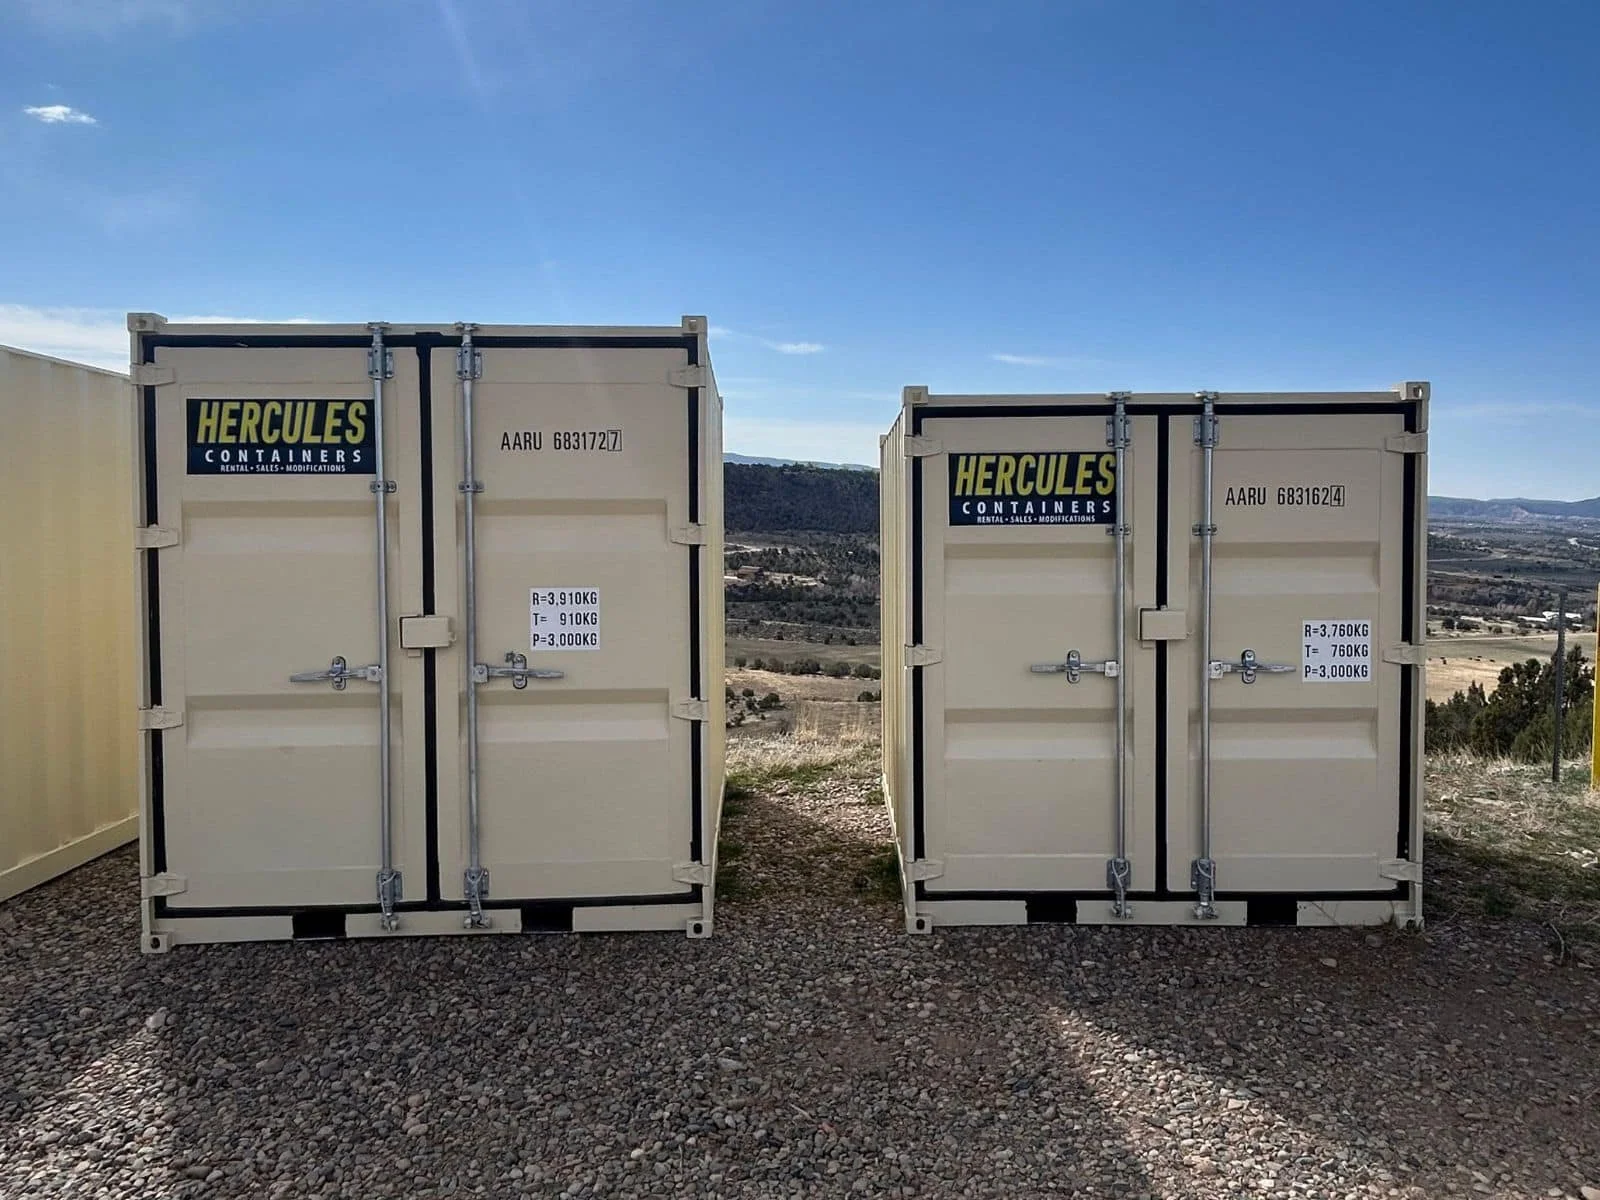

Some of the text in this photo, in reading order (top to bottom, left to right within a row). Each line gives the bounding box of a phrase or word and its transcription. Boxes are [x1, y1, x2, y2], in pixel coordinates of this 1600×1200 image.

[197, 401, 367, 444] HERCULES
[501, 431, 542, 450] AARU
[205, 450, 361, 462] CONTAINERS
[220, 464, 346, 472] RENTAL SALES MODIFICATIONS
[955, 454, 1116, 496] HERCULES
[1225, 487, 1266, 505] AARU
[962, 501, 1111, 514] CONTAINERS
[1010, 515, 1032, 523] SALES
[1039, 515, 1096, 523] MODIFICATIONS
[533, 612, 597, 626] T= 910KG
[1305, 624, 1368, 638] R=3,760KG
[533, 633, 597, 647] P=3,000KG
[1305, 644, 1368, 657] T= 760KG
[1305, 665, 1368, 679] P=3,000KG
